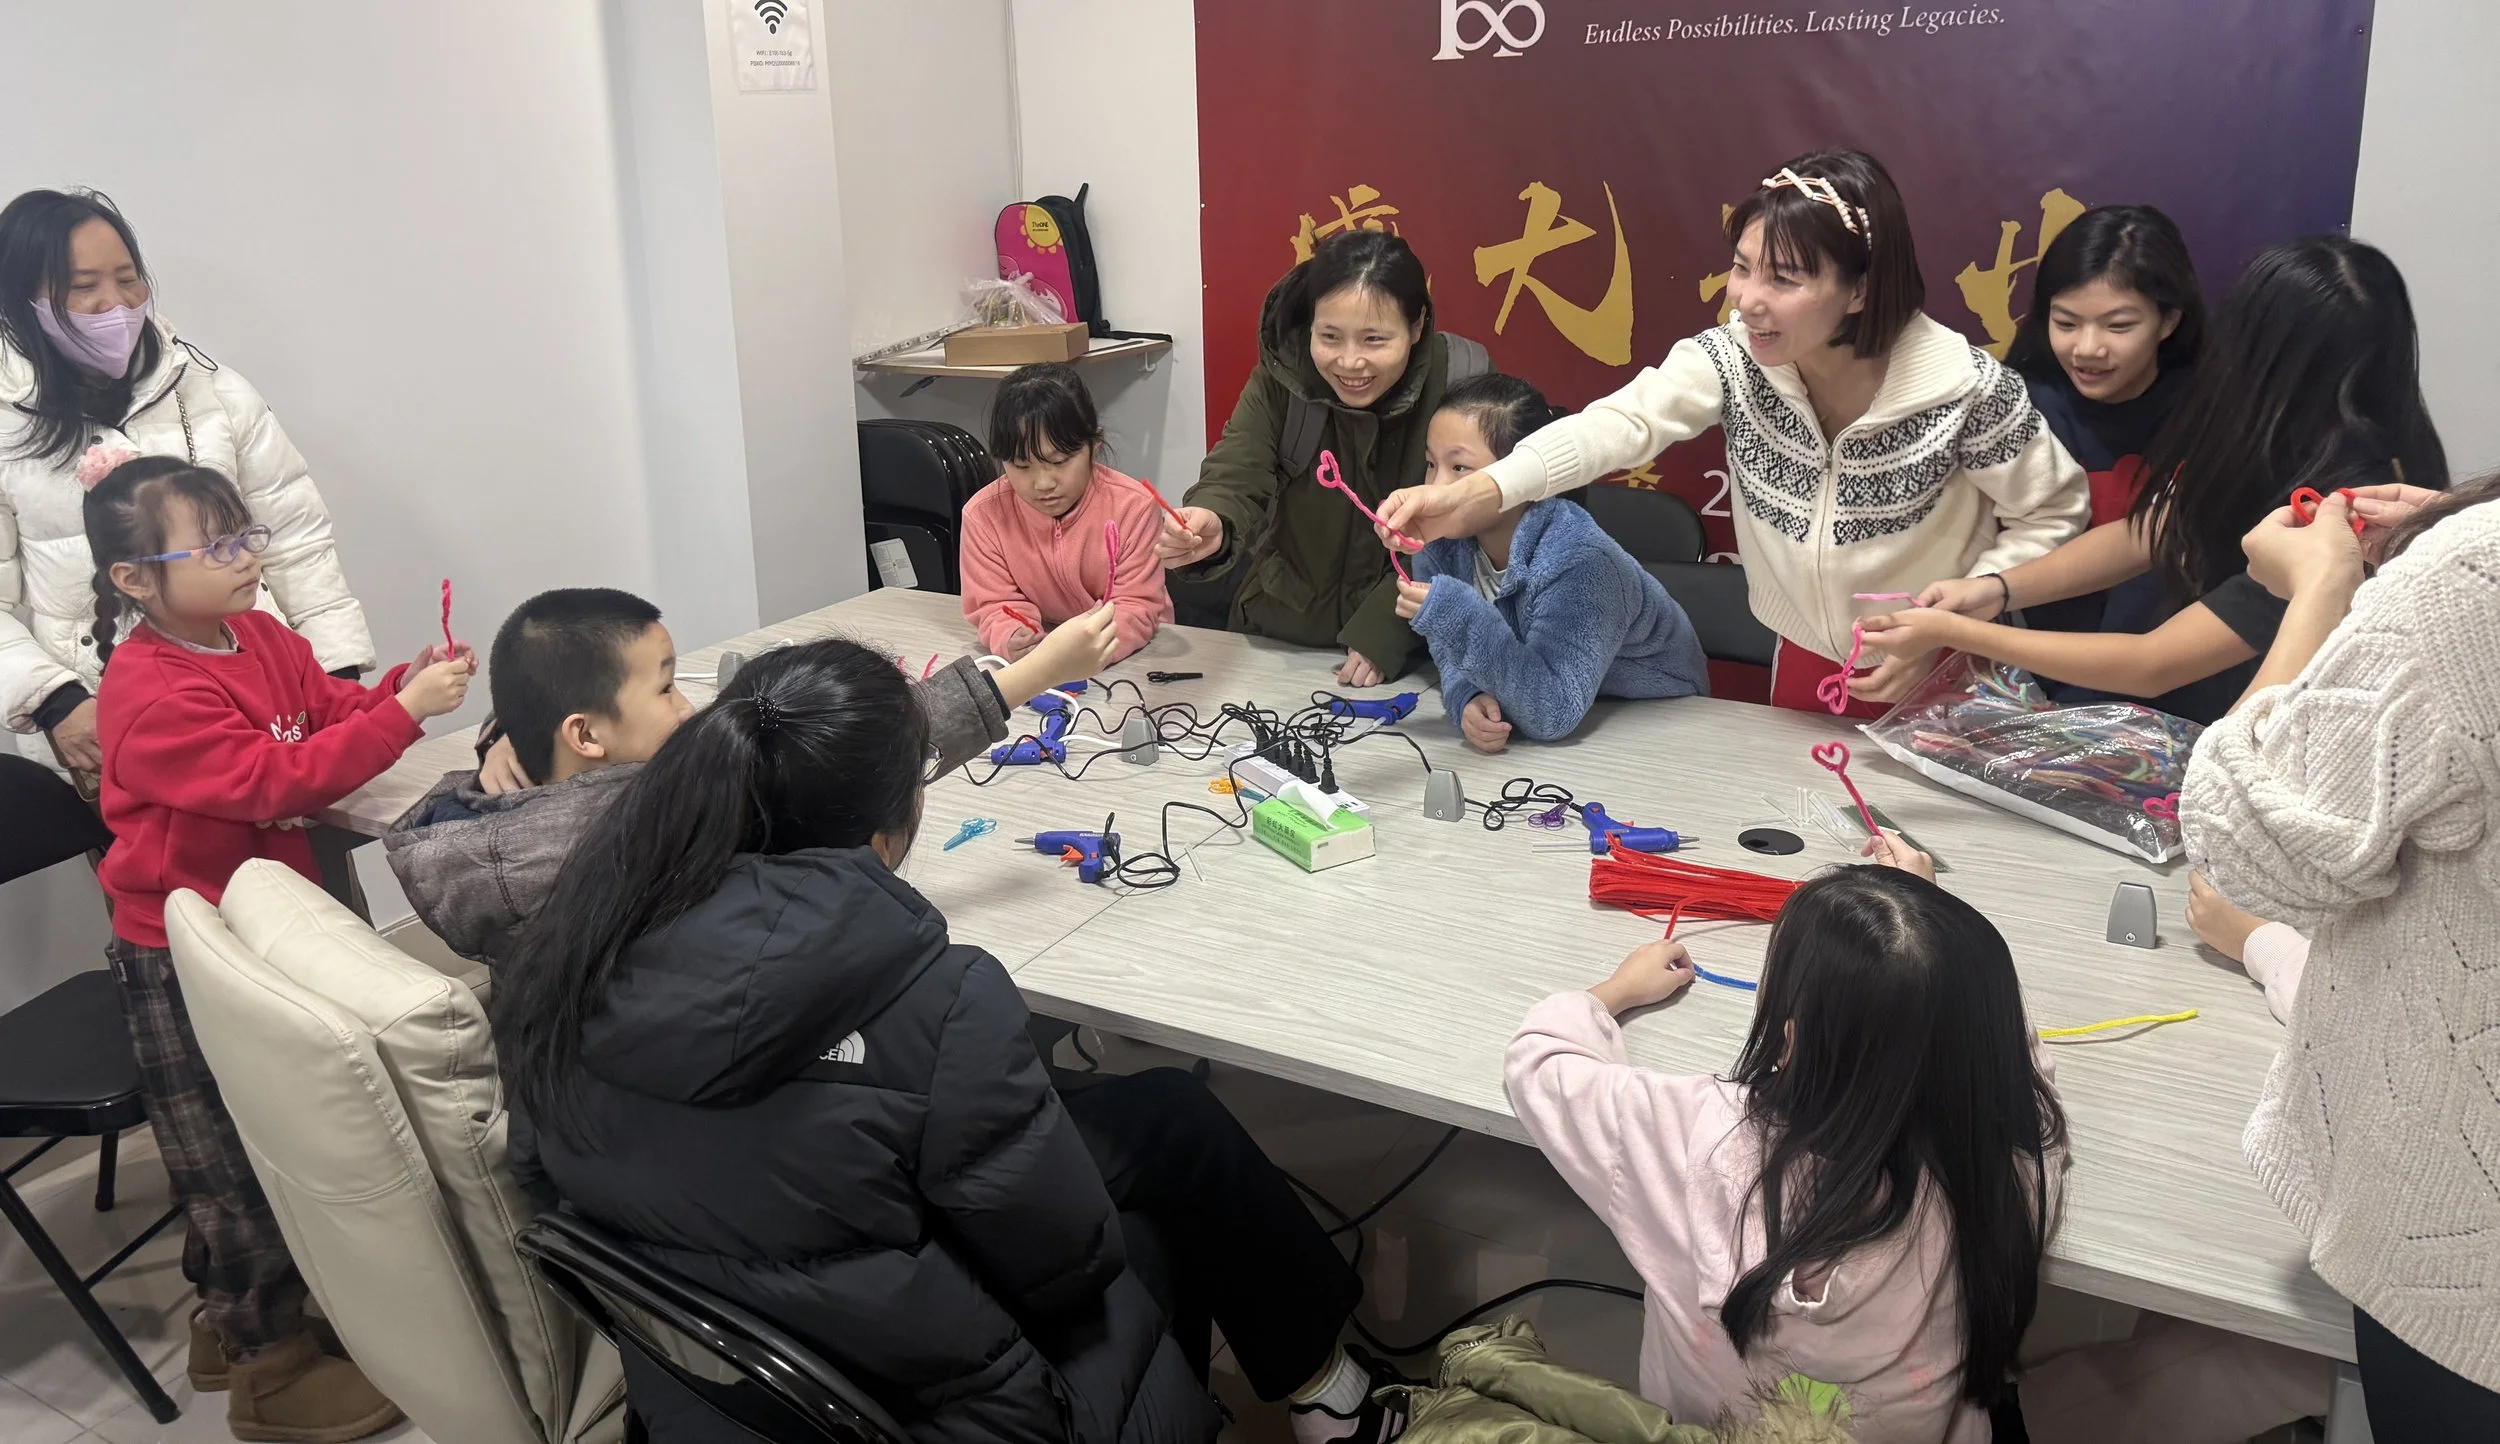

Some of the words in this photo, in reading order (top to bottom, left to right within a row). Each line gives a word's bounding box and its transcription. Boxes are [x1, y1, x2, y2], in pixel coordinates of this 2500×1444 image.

[1584, 20, 1661, 44] Endless
[1666, 13, 1799, 40] Possibilities.
[1805, 9, 1894, 36] Lasting
[1899, 3, 2005, 34] Legacies.
